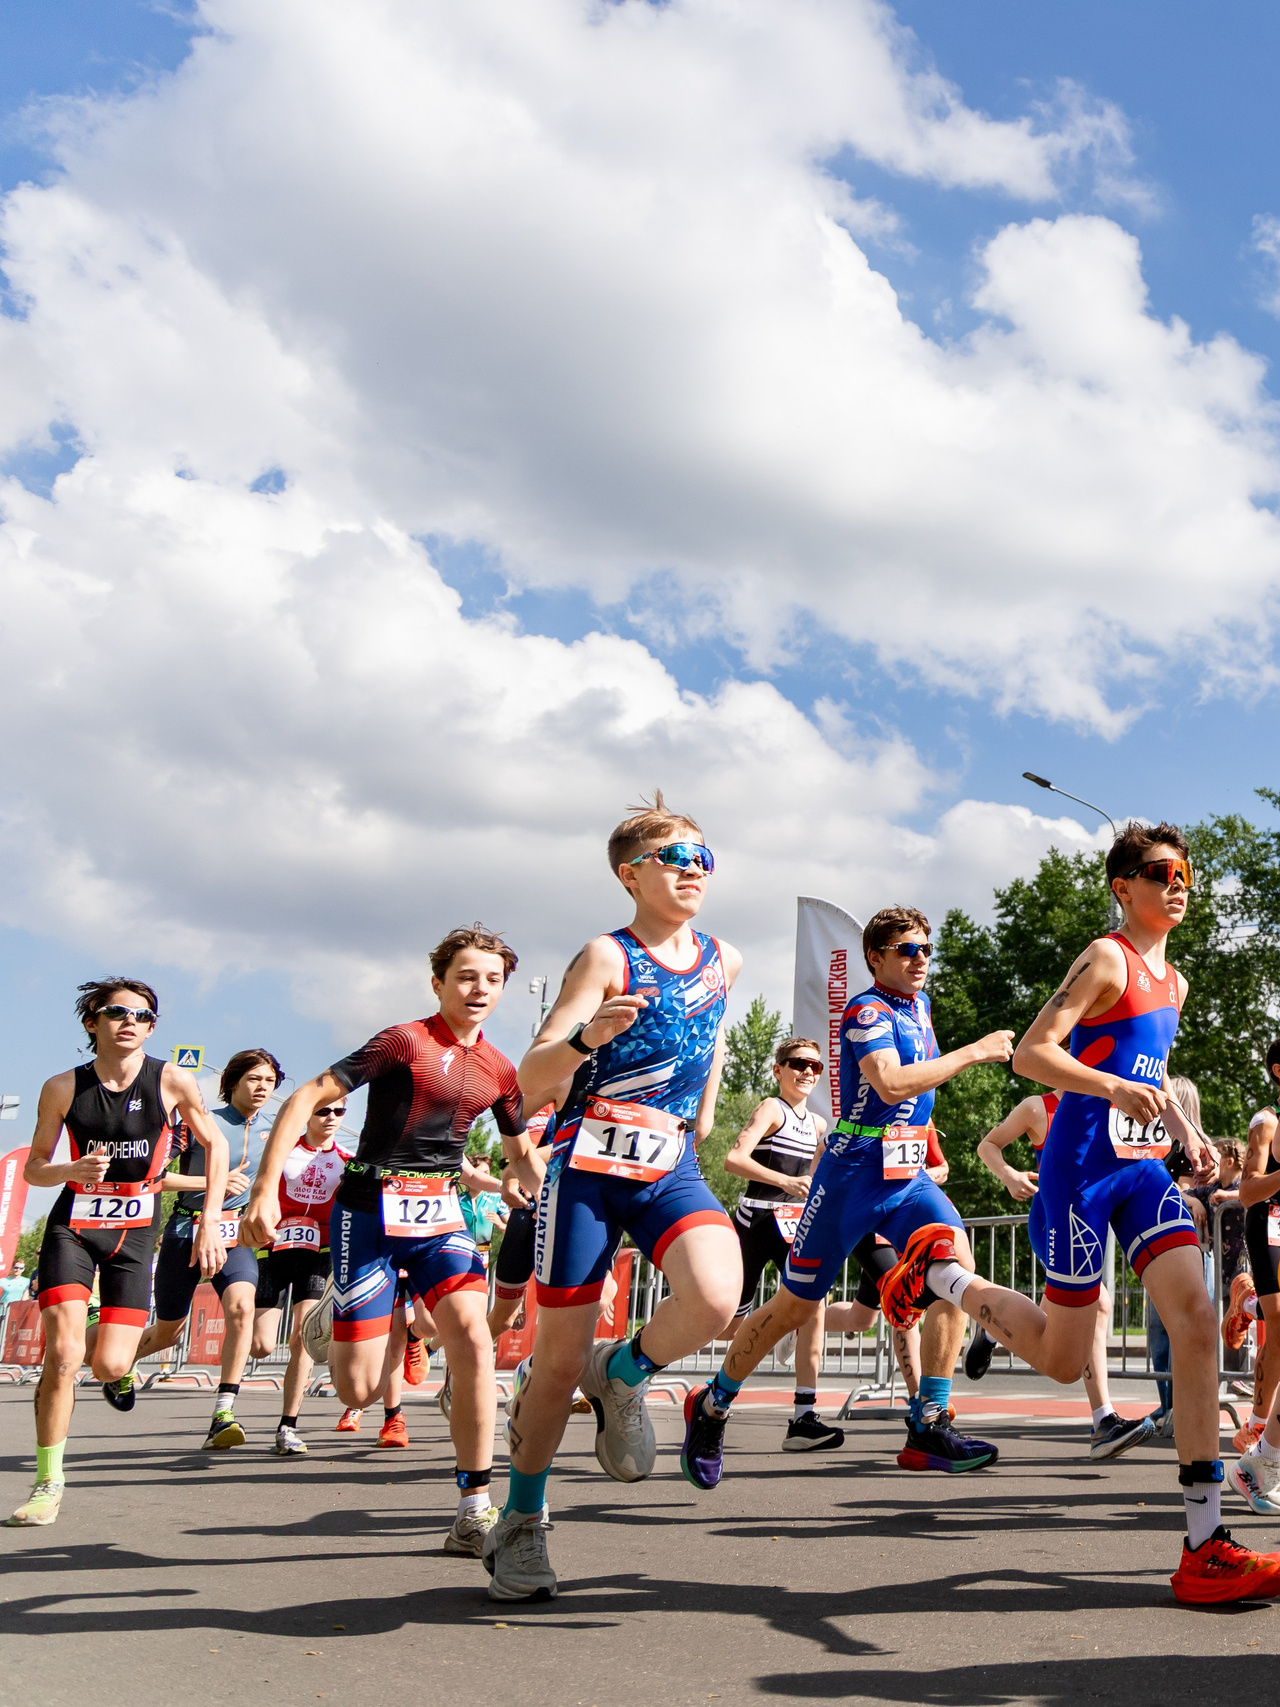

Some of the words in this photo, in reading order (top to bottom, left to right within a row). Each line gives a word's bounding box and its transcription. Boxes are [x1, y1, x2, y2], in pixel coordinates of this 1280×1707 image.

[828, 949, 848, 1014] МОСКВЫ
[1132, 1053, 1164, 1081] RUS
[597, 1127, 667, 1163] 117
[1123, 1115, 1166, 1143] 116
[89, 1198, 141, 1218] 120
[399, 1199, 447, 1224] 122
[793, 1184, 826, 1257] AQUATICS
[219, 1223, 236, 1238] 33
[283, 1227, 315, 1242] 130
[534, 1173, 551, 1277] AQUATICS
[340, 1210, 352, 1284] AQUATICS
[1049, 1228, 1057, 1267] TITAN
